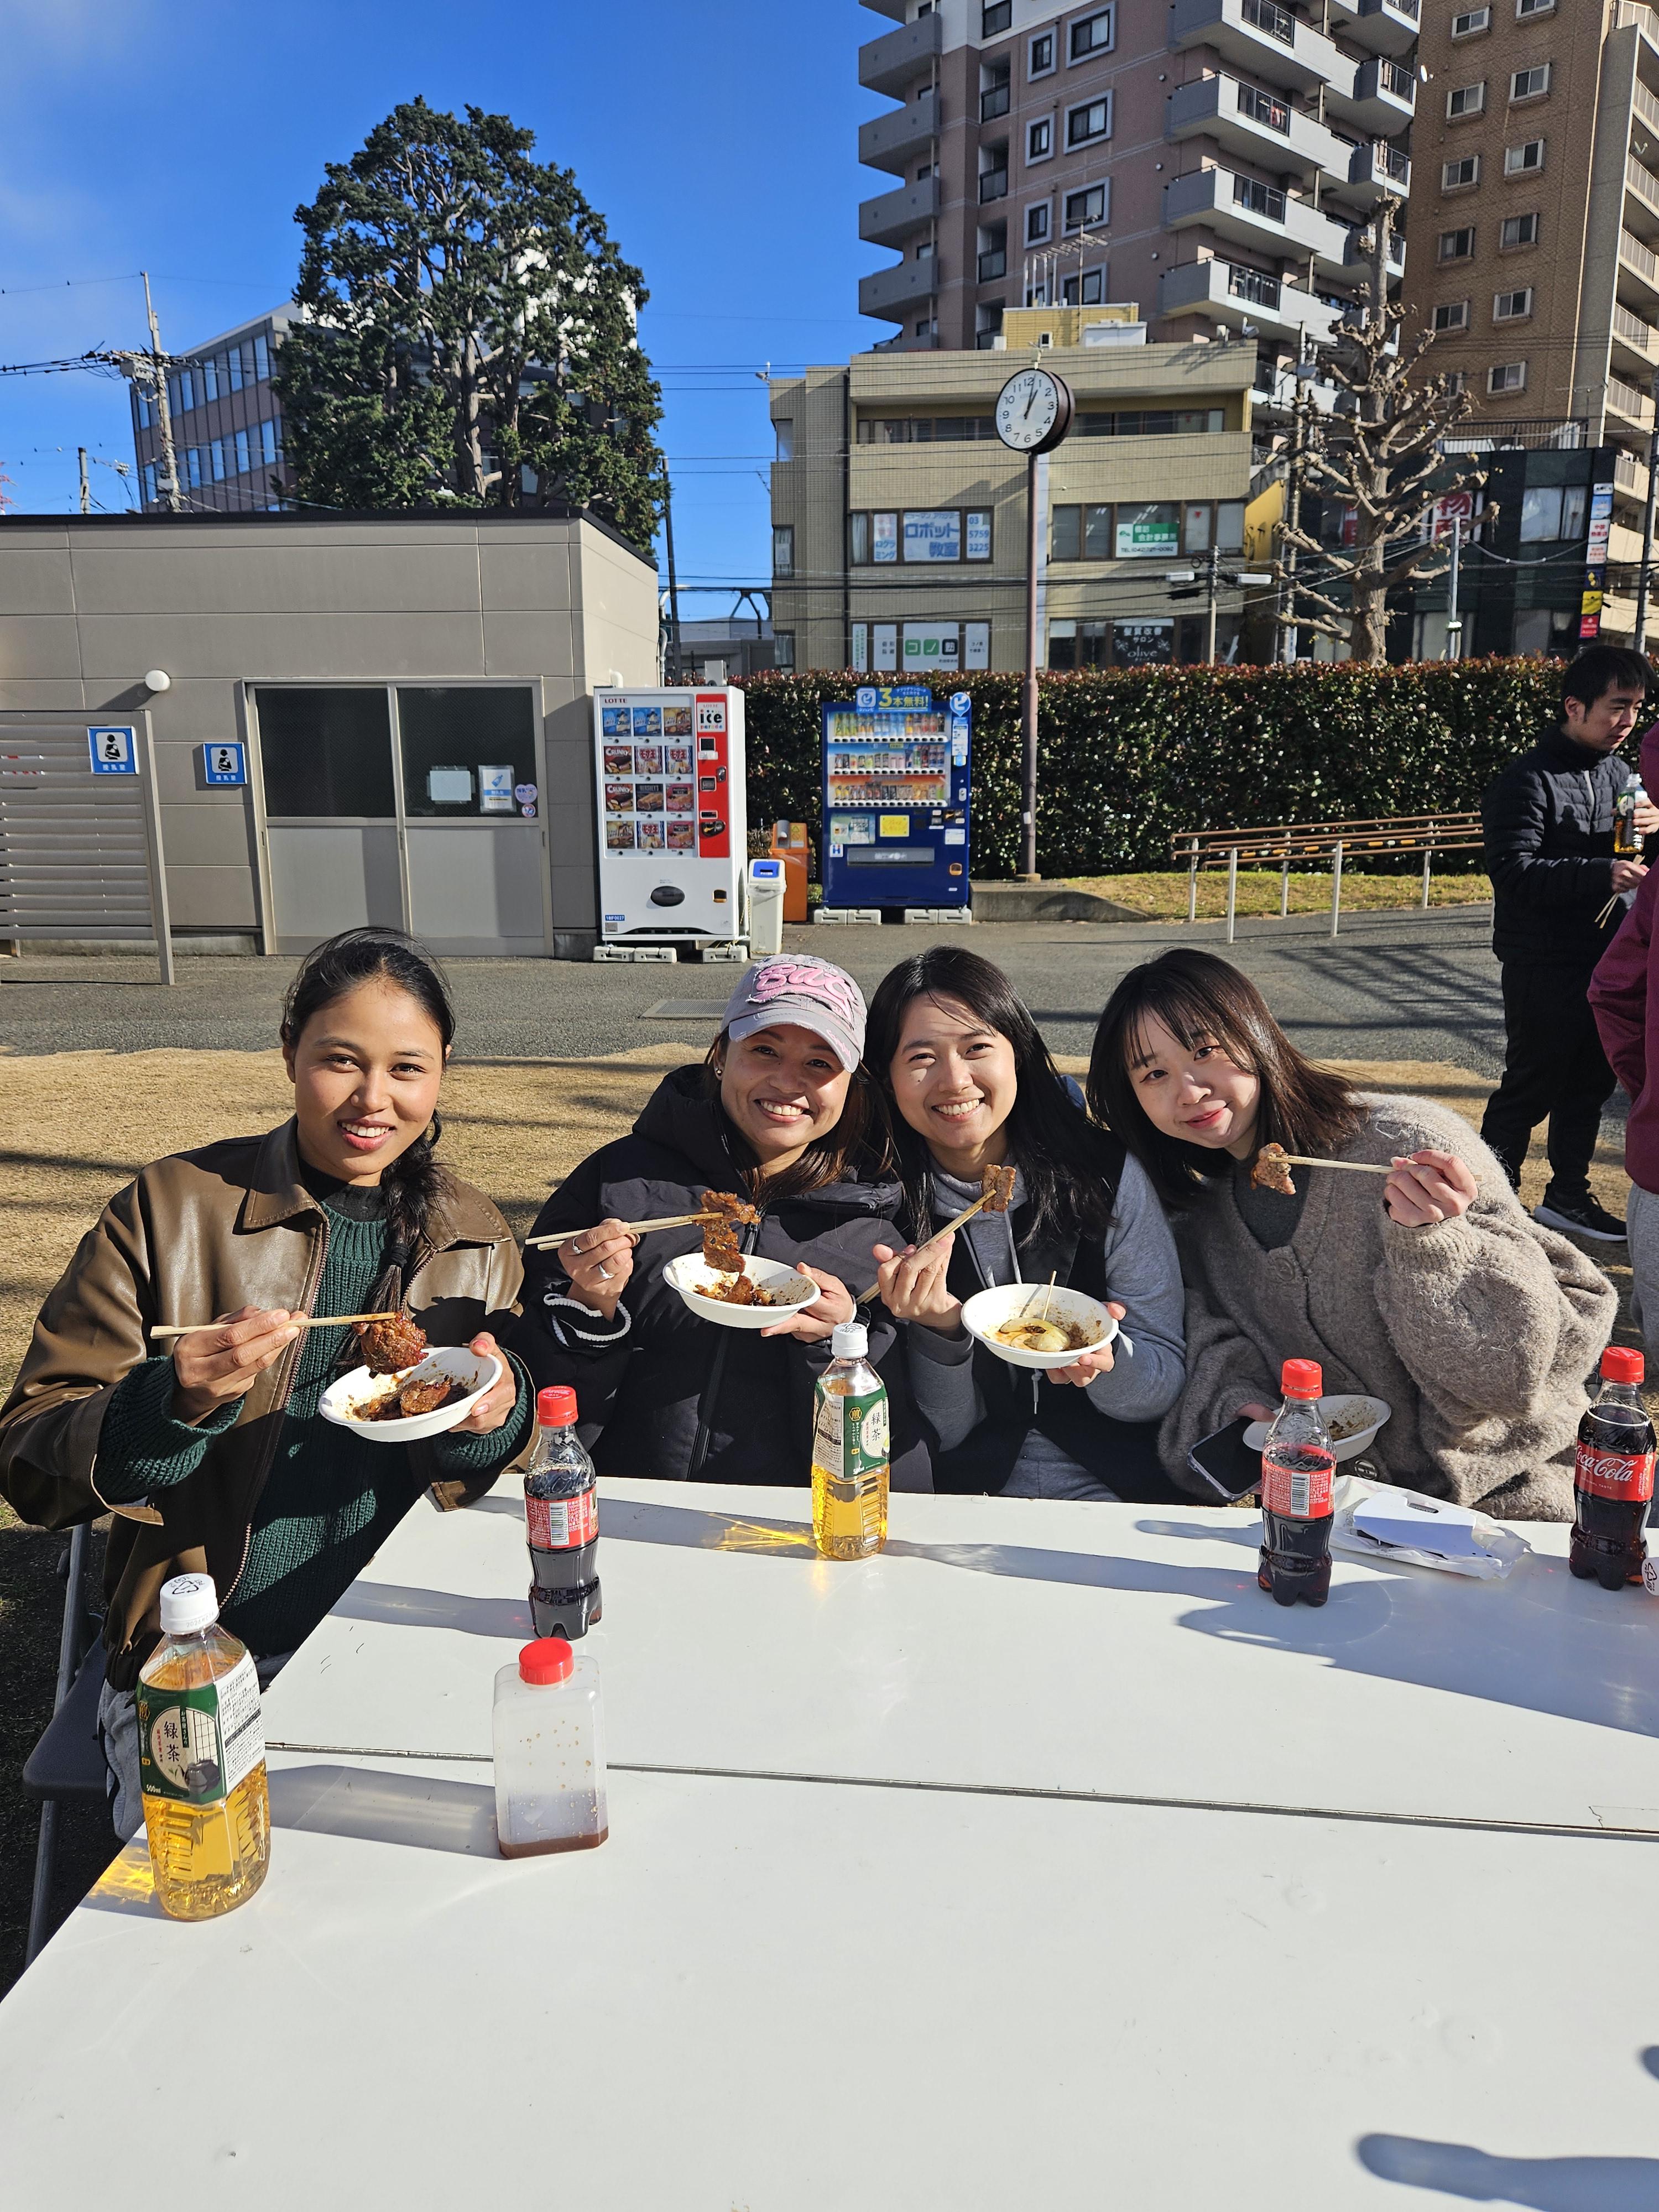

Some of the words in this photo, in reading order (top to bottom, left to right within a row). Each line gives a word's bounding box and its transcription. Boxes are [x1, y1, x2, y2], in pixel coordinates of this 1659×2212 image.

[1024, 377, 1035, 387] 12
[1013, 384, 1021, 393] 11
[1045, 387, 1052, 397] 2
[1004, 395, 1015, 405] 10
[1047, 401, 1055, 410] 3
[1002, 410, 1009, 419] 9
[1005, 424, 1012, 432] 8
[1035, 428, 1043, 437] 5
[1014, 432, 1020, 441] 7
[1024, 434, 1031, 442] 6
[969, 517, 979, 525] 03
[905, 522, 959, 538] ロボット
[969, 530, 989, 538] 5759
[875, 540, 896, 549] ログラ
[929, 541, 959, 557] 教室
[969, 543, 989, 552] 3225
[875, 551, 896, 560] ミング
[1127, 645, 1158, 658] olive
[700, 708, 723, 724] ice
[871, 1412, 881, 1442] 緑茶
[1576, 1445, 1639, 1482] Coca-Cola
[164, 1720, 180, 1762] 緑茶
[146, 1783, 161, 1794] 500ml
